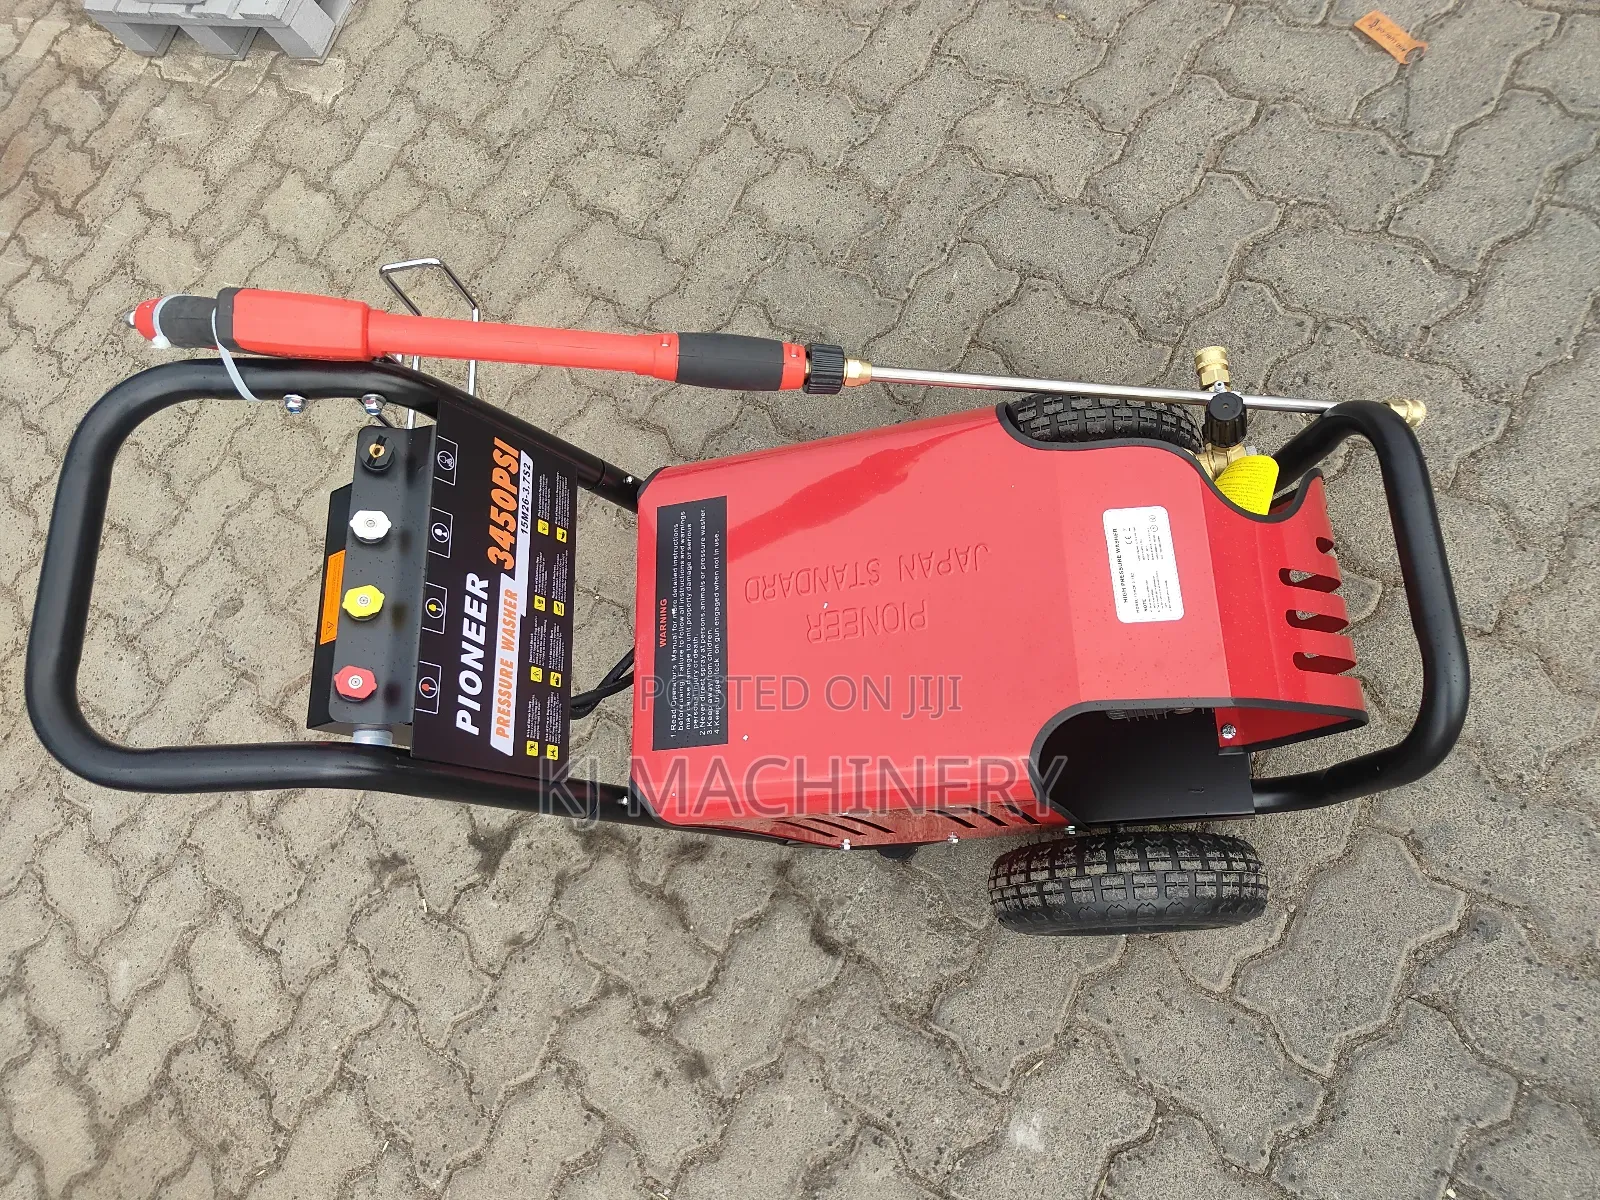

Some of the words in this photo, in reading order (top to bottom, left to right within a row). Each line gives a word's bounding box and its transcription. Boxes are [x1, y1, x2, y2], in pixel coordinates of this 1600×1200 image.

[487, 437, 519, 571] 3450PSI
[744, 558, 881, 604] STANDARD
[897, 542, 991, 582] JAPAN
[1117, 554, 1126, 586] PRESSURE
[1120, 588, 1128, 603] HIGH
[500, 589, 518, 652] WASHER
[806, 599, 928, 644] PIONEER
[455, 572, 489, 736] PIONEER
[694, 660, 698, 668] or
[700, 645, 705, 653] at
[714, 644, 719, 654] on
[495, 658, 514, 739] PRESSURE
